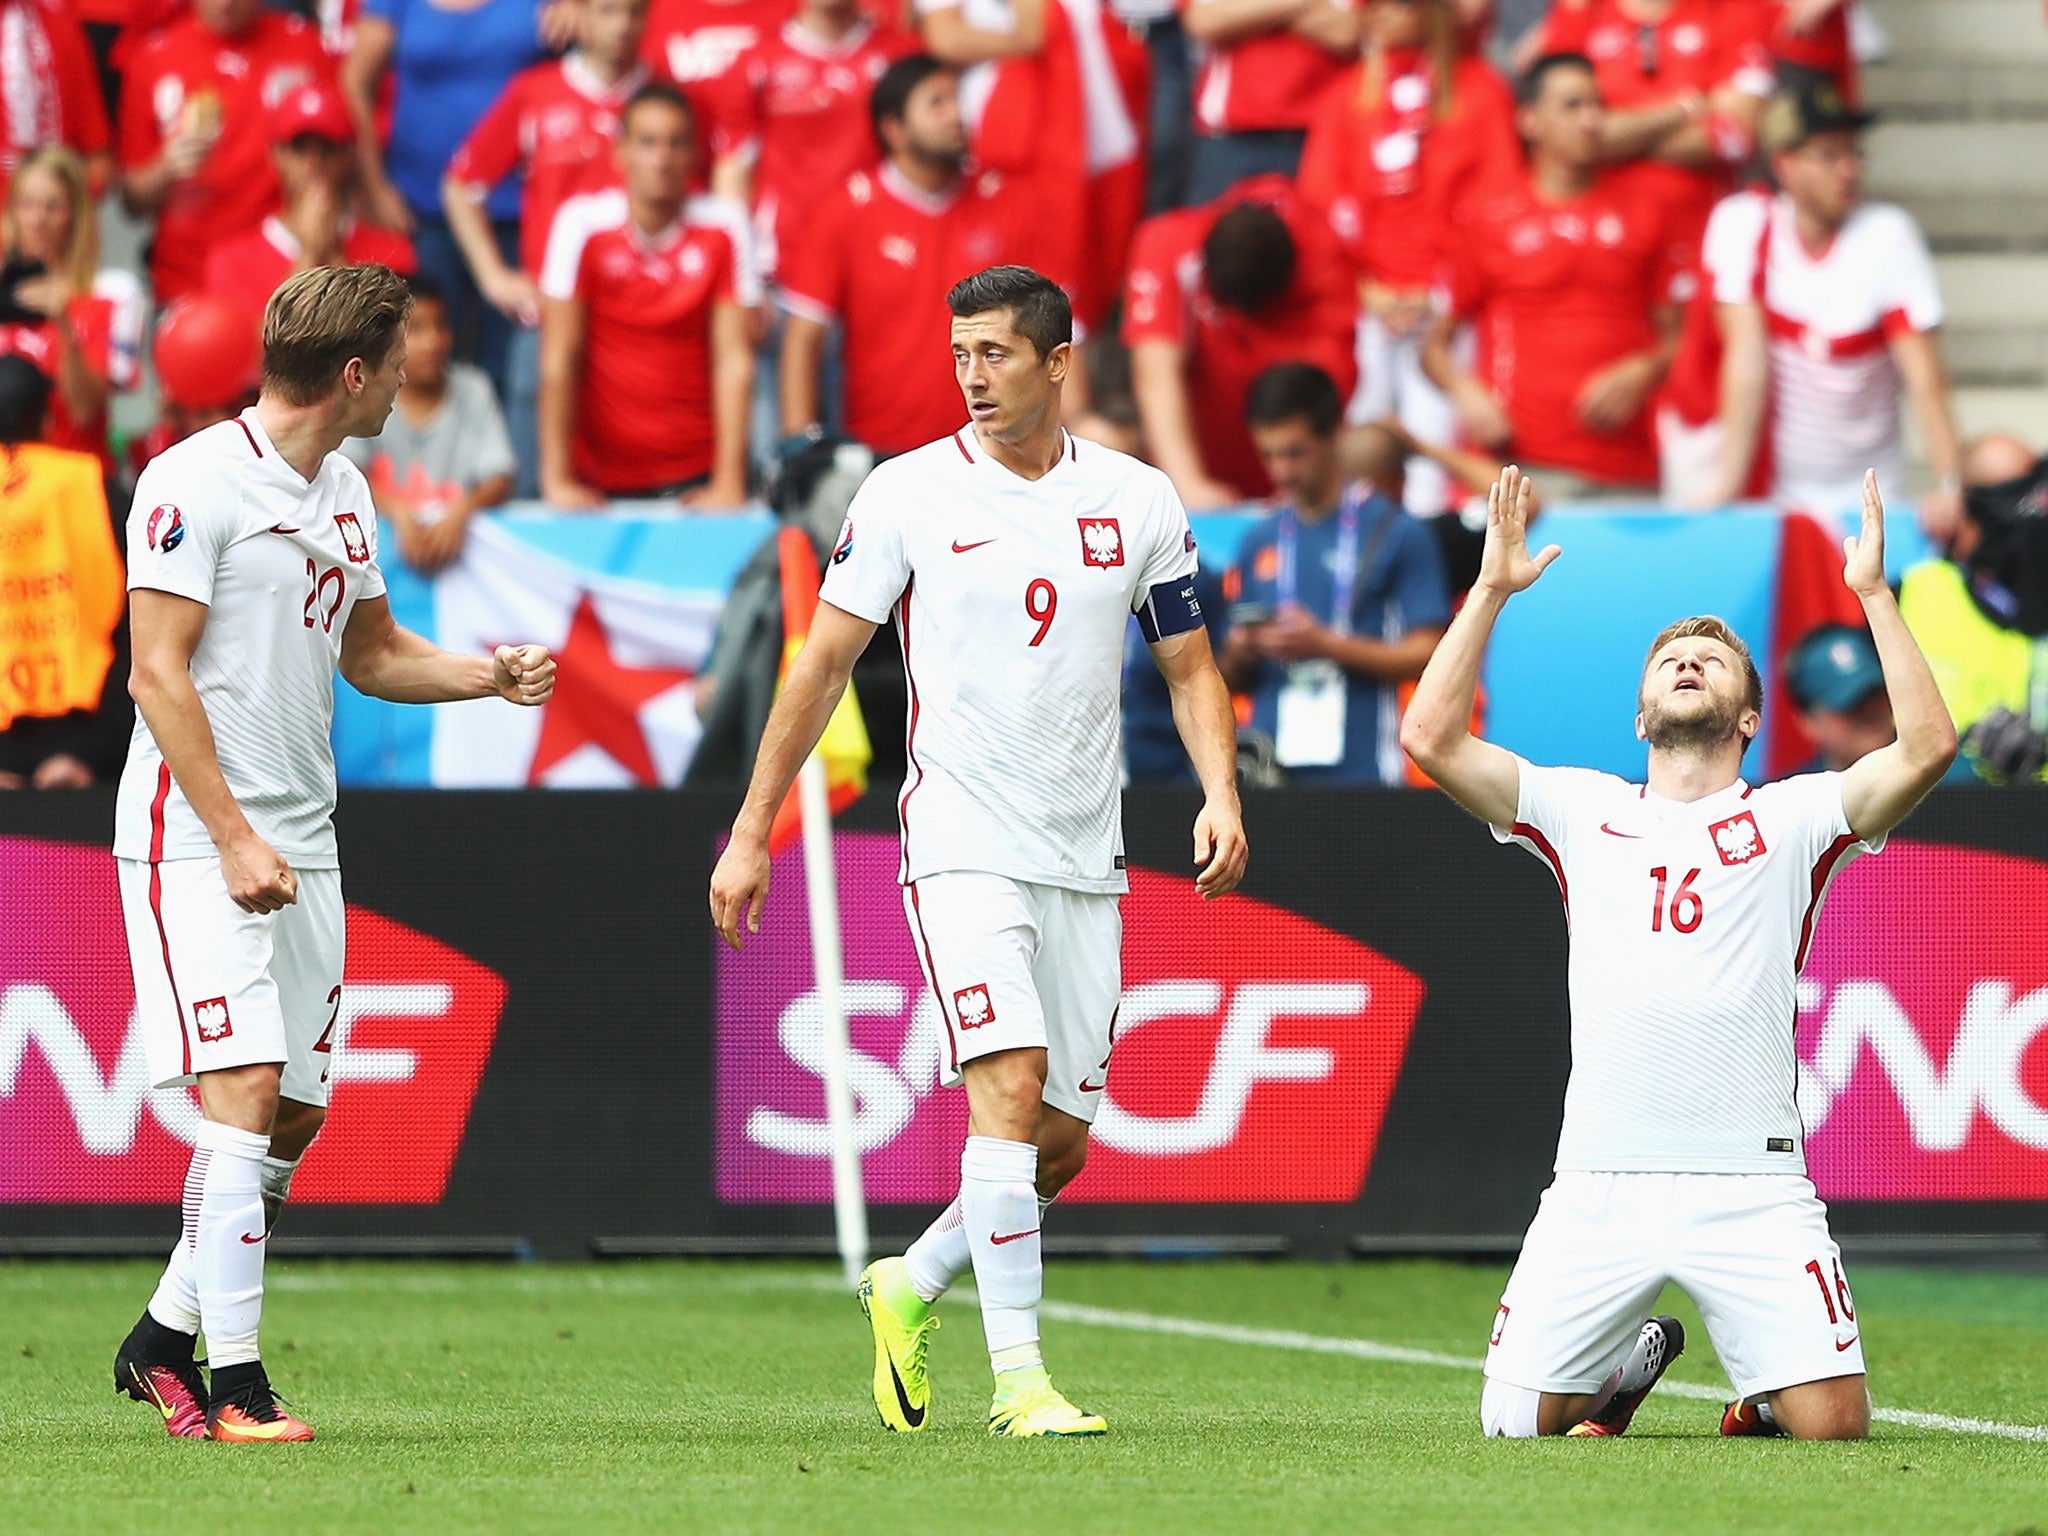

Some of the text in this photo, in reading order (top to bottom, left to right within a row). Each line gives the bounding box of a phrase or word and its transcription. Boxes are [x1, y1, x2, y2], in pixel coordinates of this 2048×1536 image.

[303, 557, 346, 634] 20
[1025, 577, 1058, 647] 9
[1649, 865, 1703, 934] 16
[0, 980, 455, 1155] NF
[743, 977, 1372, 1159] SCF
[1796, 976, 2048, 1152] NC
[1804, 1256, 1854, 1325] 16
